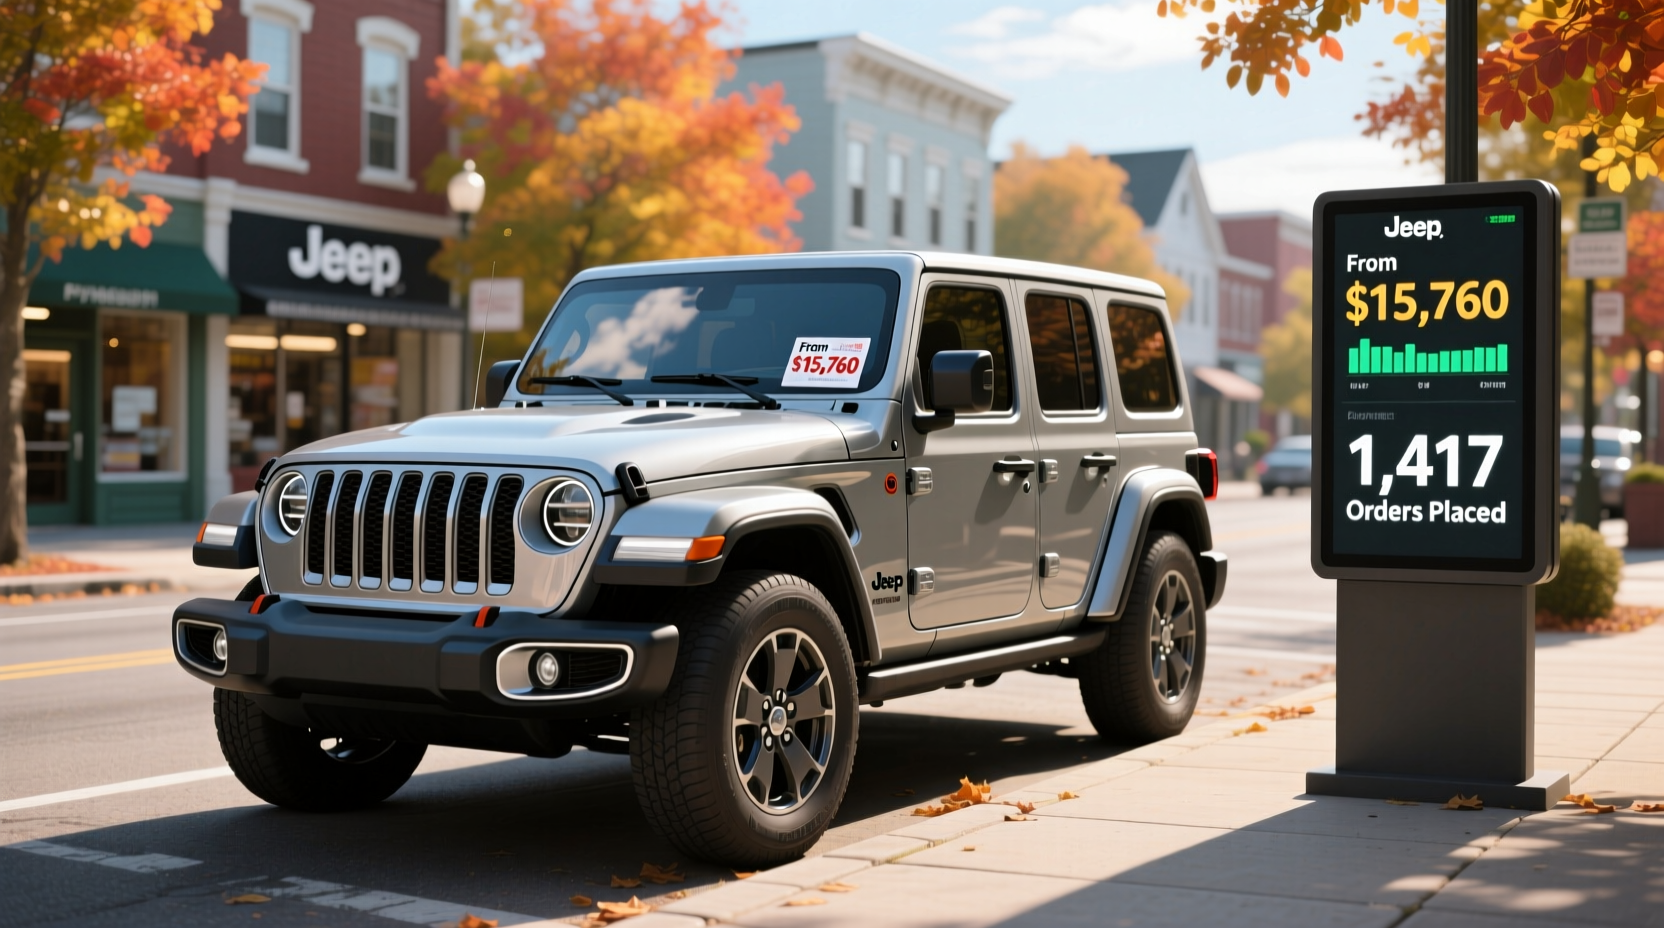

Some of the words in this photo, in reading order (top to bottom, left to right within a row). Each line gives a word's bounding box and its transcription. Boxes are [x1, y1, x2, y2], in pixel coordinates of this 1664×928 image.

[288, 225, 401, 295] Jeep
[1346, 254, 1398, 273] From
[1345, 279, 1509, 328] $15,760
[792, 355, 860, 375] $15,760
[1348, 433, 1504, 496] 1,417
[1346, 499, 1424, 522] Orders
[1429, 499, 1507, 524] Placed
[871, 571, 904, 593] Jeep
